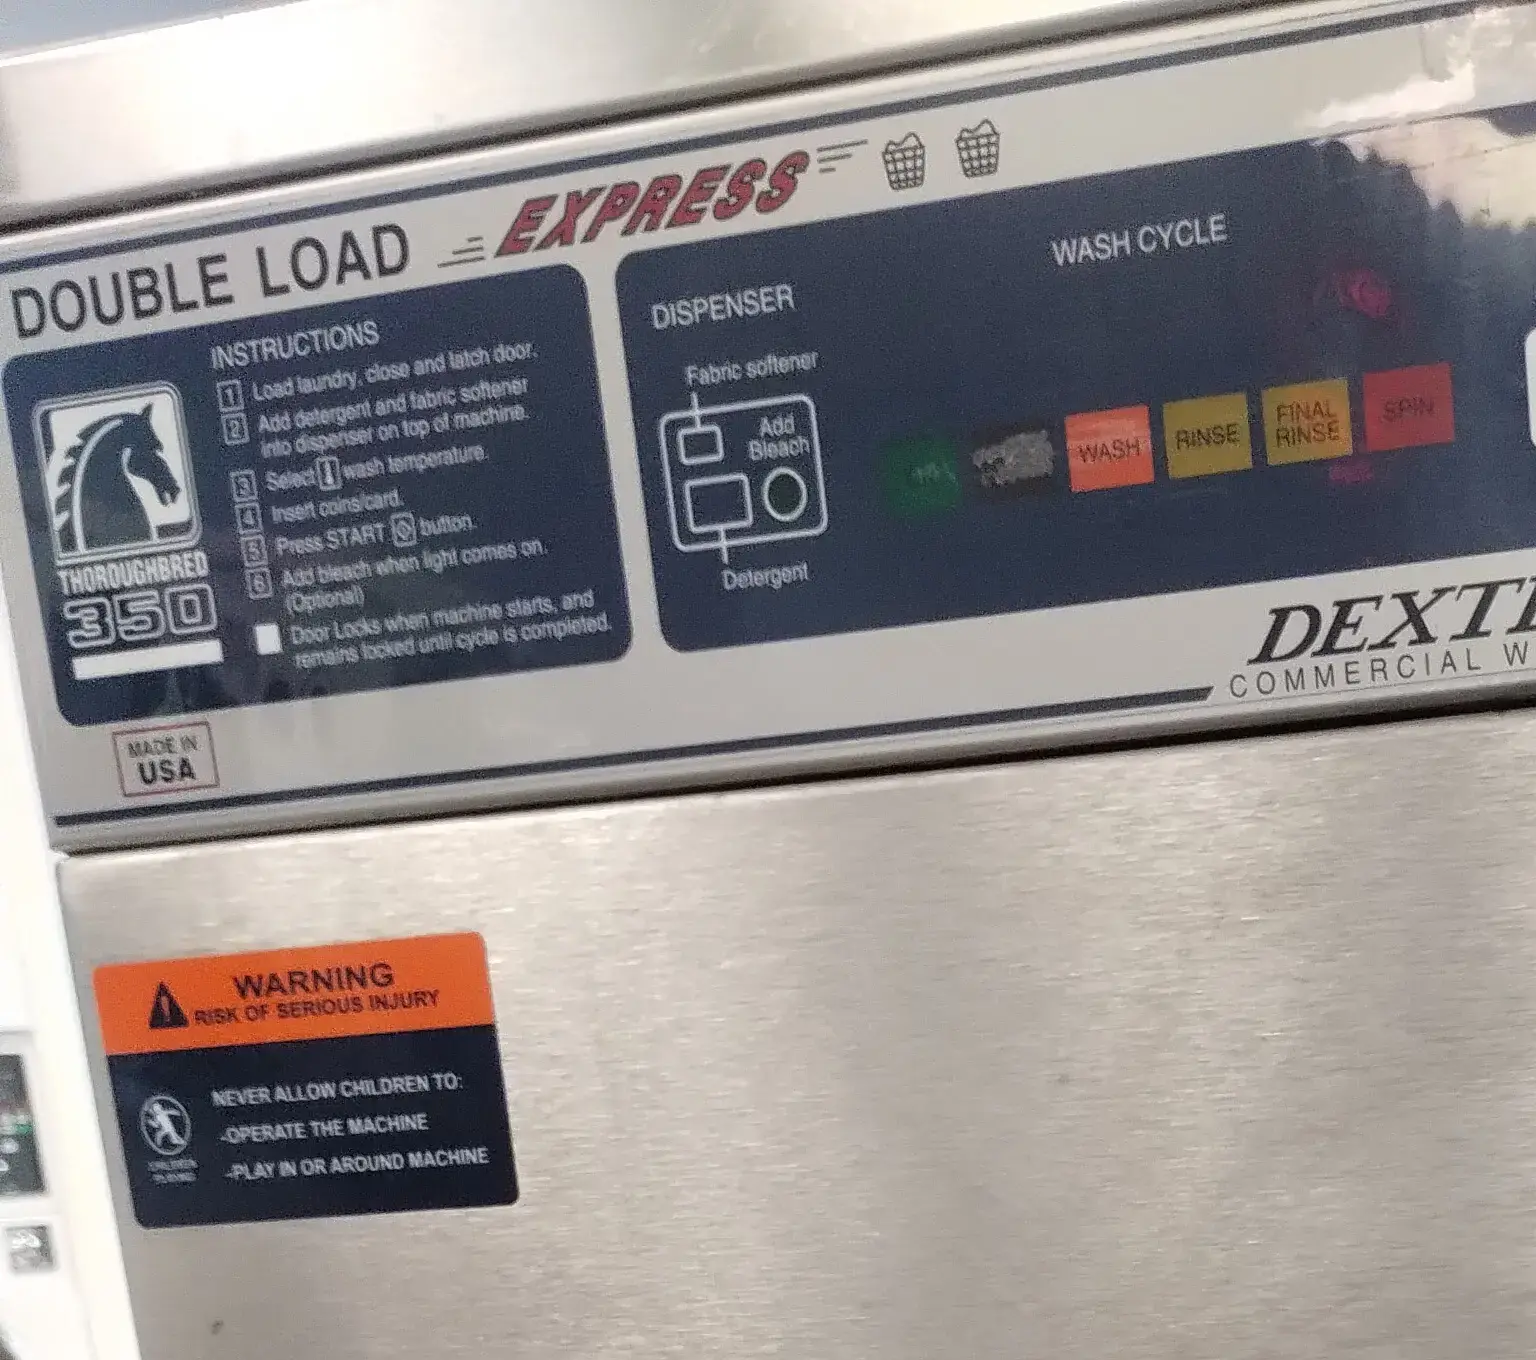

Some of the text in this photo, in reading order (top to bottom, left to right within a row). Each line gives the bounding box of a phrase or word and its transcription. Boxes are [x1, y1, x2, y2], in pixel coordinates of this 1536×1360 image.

[494, 150, 810, 258] EXPRESS
[1051, 214, 1228, 266] WASH CYCLE
[12, 223, 410, 338] DOUBLE LOAD
[652, 284, 797, 329] DISPENSER
[211, 321, 379, 369] INSTRUCTIONS
[252, 377, 295, 400] Load
[414, 353, 446, 376] and
[493, 342, 539, 363] door.
[686, 350, 819, 386] Fabric softener
[258, 411, 291, 433] Add
[375, 393, 406, 416] and
[460, 378, 528, 403] softener
[1276, 400, 1336, 422] FINAL
[1382, 397, 1435, 423] SPIN
[378, 423, 399, 441] on
[402, 419, 430, 439] top
[433, 412, 449, 432] of
[760, 415, 795, 437] Add
[1175, 423, 1239, 450] RINSE
[1276, 422, 1340, 448] RINSE
[749, 436, 810, 460] Bleach
[1079, 437, 1141, 463] WASH
[325, 523, 383, 549] START
[57, 550, 209, 596] THOROUGHBRED
[722, 561, 808, 590] Detergent
[561, 589, 594, 610] and
[64, 583, 218, 649] 350
[503, 626, 518, 642] is
[1229, 648, 1482, 698] COMMERCIAL
[128, 734, 199, 758] MADE IN
[138, 757, 197, 785] USA
[232, 962, 394, 999] WARNING
[194, 989, 440, 1025] RISK OF SERIOUS INJURY
[211, 1071, 463, 1106] NEVER ALLOW CHILDREN TO:
[309, 1119, 345, 1137] THE
[347, 1112, 429, 1135] MACHINE
[278, 1160, 297, 1177] IN
[300, 1158, 327, 1176] OR
[331, 1153, 404, 1174] AROUND
[407, 1147, 489, 1168] MACHINE
